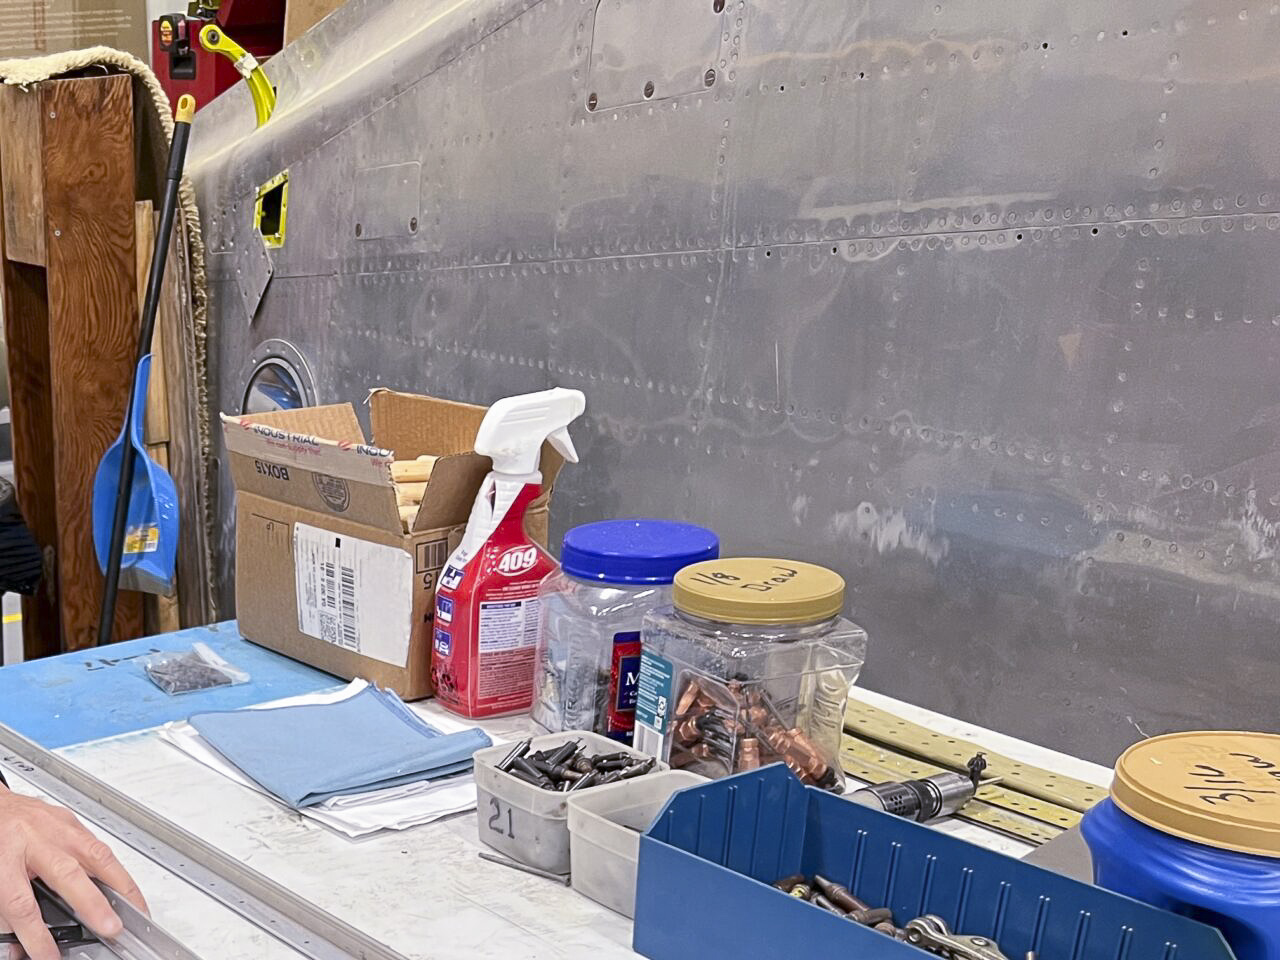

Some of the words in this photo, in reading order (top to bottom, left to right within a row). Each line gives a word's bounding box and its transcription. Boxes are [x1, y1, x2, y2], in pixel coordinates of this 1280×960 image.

[256, 460, 290, 481] BOX15
[498, 547, 538, 573] 409
[488, 796, 516, 840] 21
